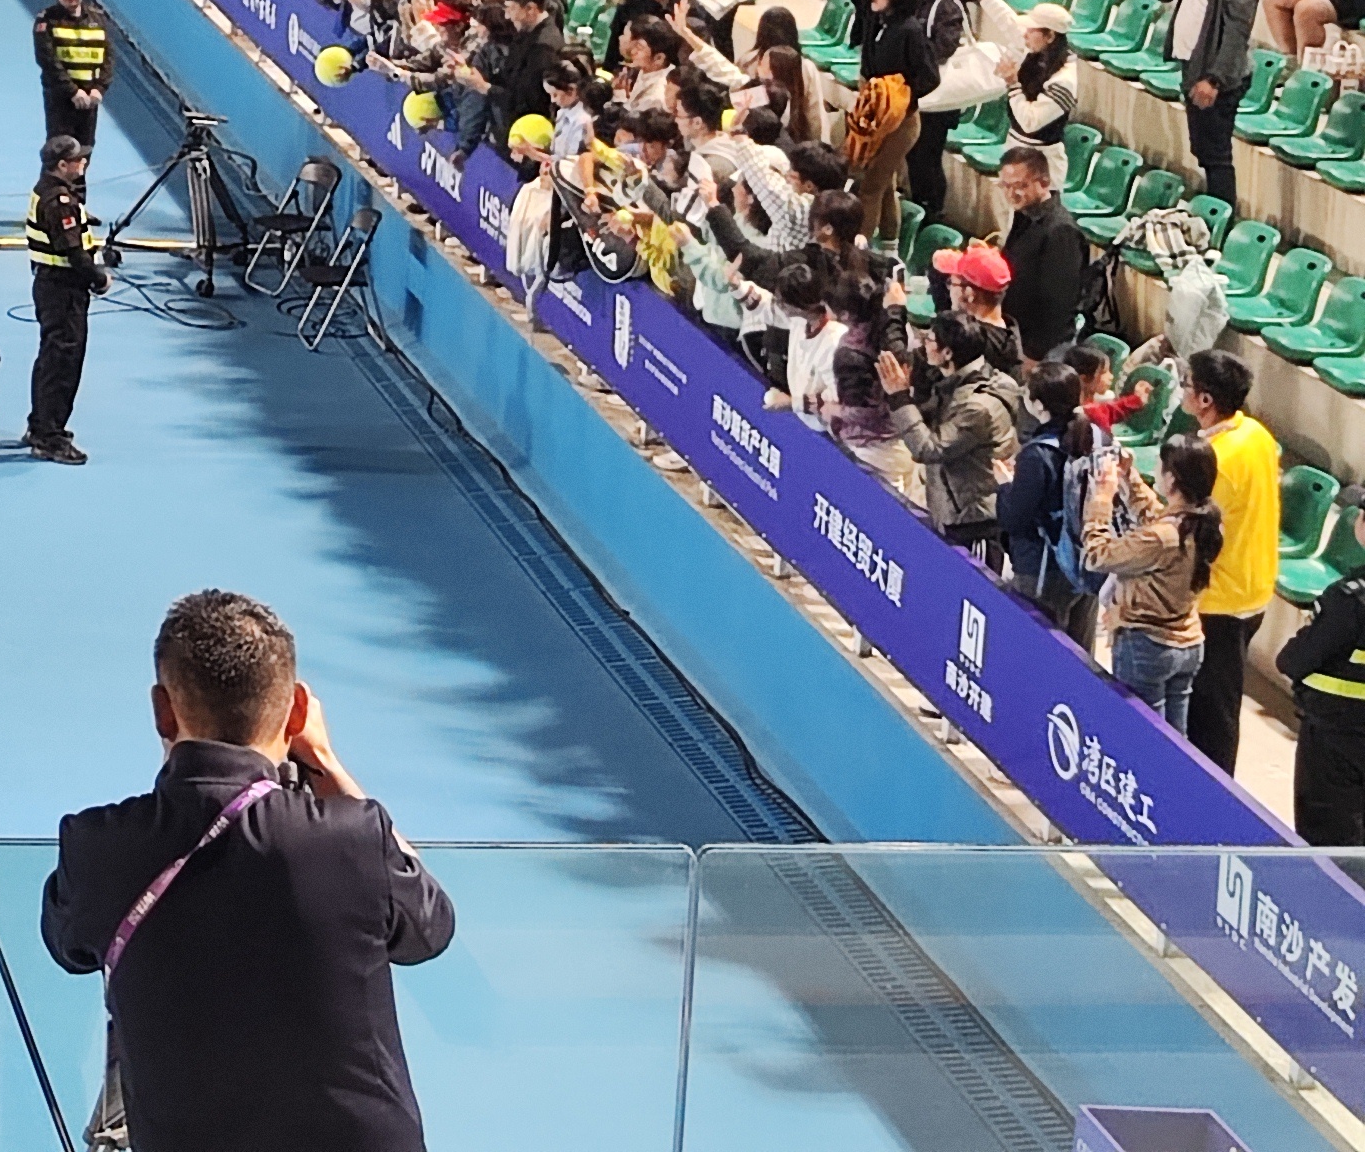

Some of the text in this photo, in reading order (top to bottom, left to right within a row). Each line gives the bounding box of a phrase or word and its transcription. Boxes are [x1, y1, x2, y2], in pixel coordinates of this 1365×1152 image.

[479, 185, 500, 226] UHS
[813, 492, 904, 608] 开建经贸大厦
[945, 659, 992, 723] 南沙开建
[1082, 735, 1157, 835] 湾区建工
[1255, 890, 1358, 1021] 南沙产发
